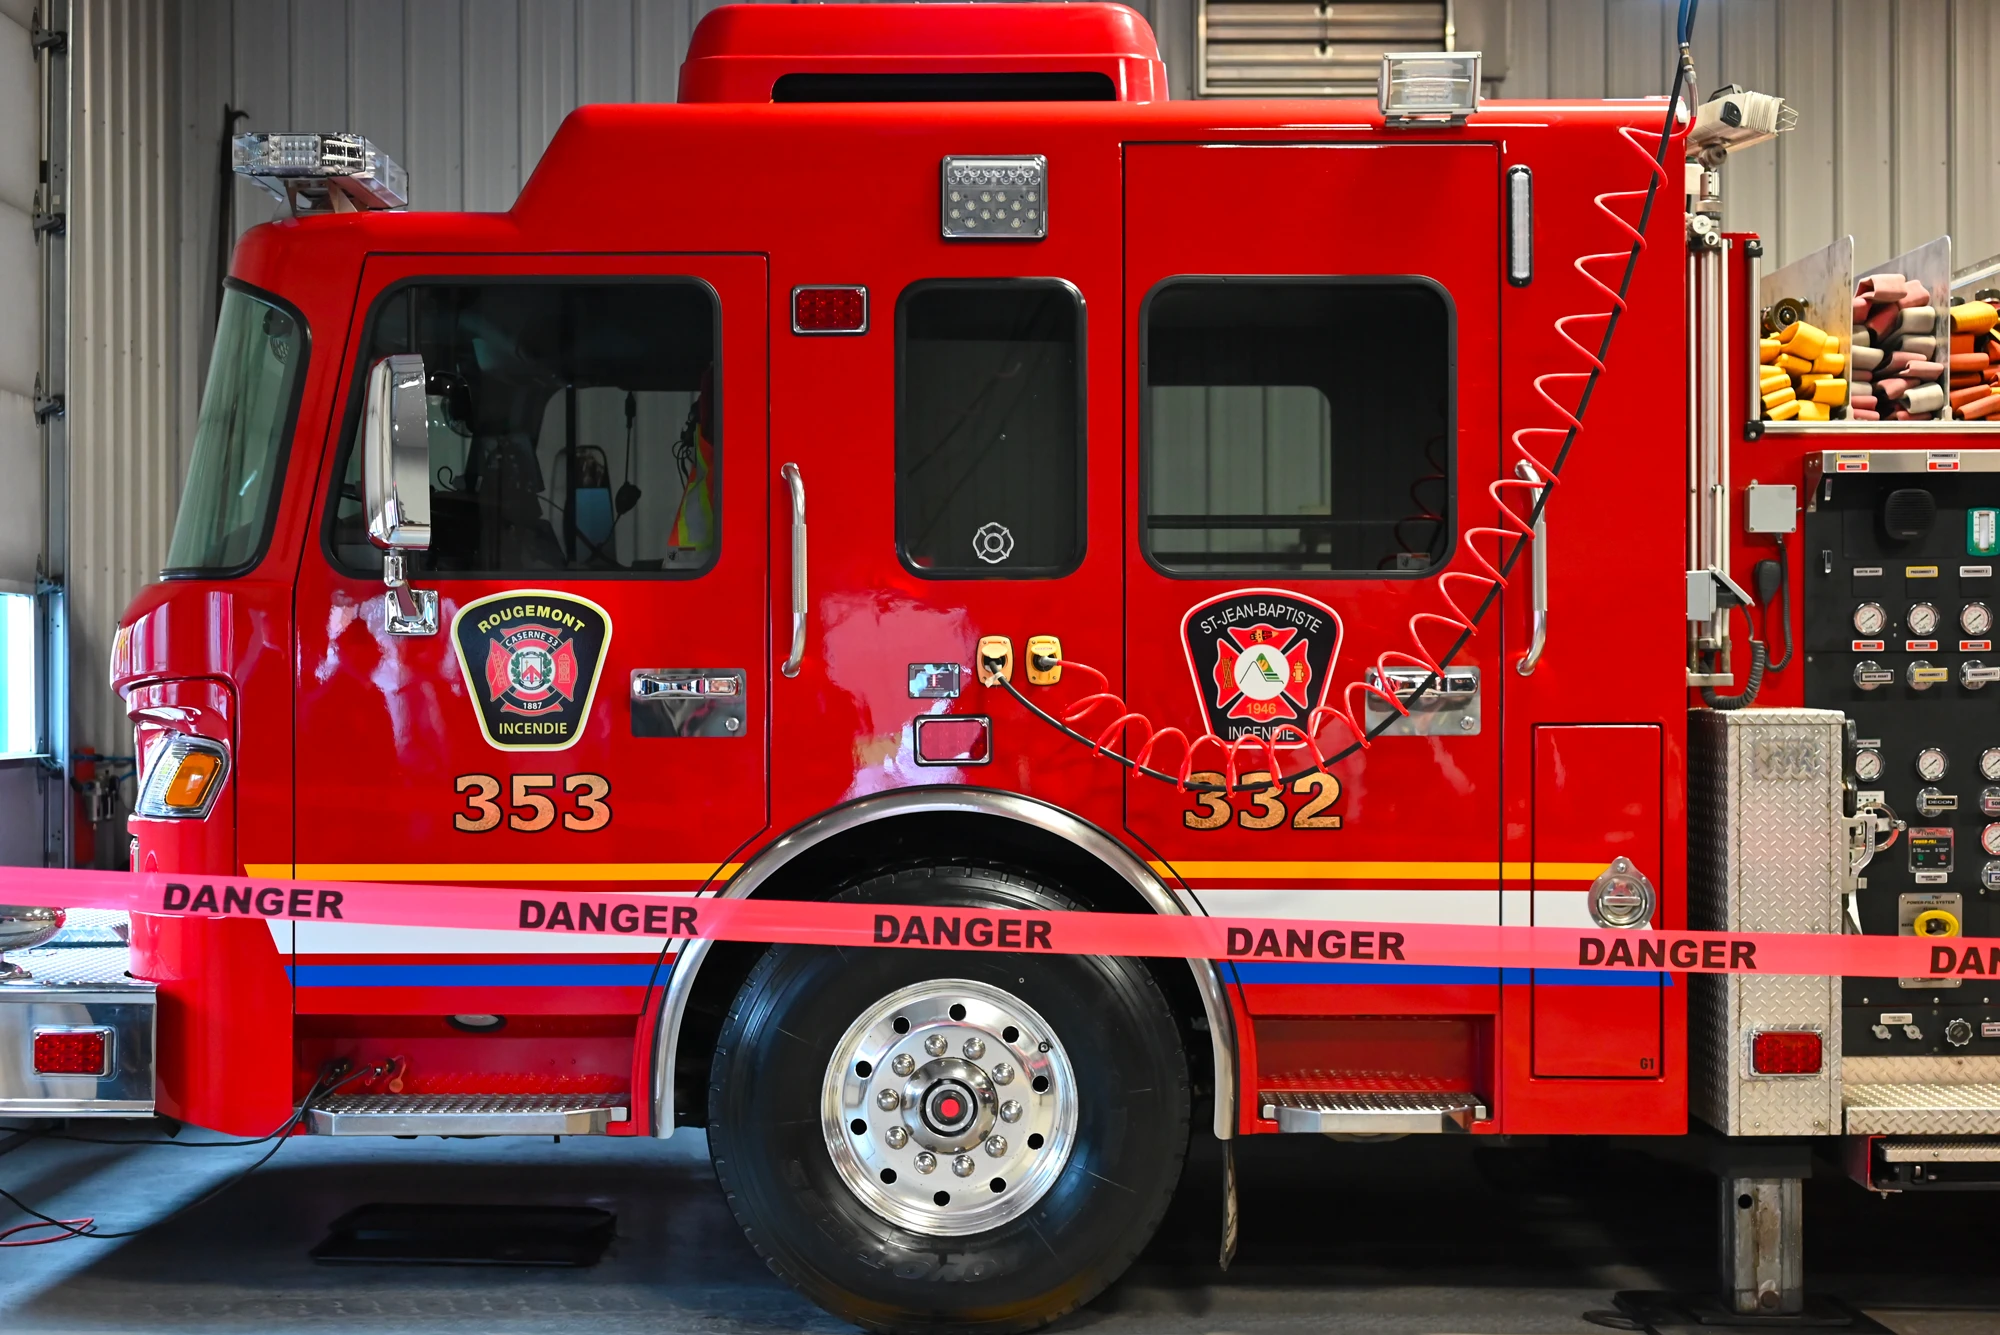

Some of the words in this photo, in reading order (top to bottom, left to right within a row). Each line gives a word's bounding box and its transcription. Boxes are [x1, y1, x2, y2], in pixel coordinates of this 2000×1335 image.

[478, 604, 586, 634] ROUGEMONT
[1200, 602, 1322, 634] ST-JEAN-BAPTISTE
[505, 630, 546, 646] CASERNE
[547, 636, 559, 647] 53
[522, 702, 542, 710] 1887
[1246, 704, 1276, 715] 1946
[499, 722, 568, 735] INCENDIE
[453, 772, 612, 834] 353
[1183, 770, 1344, 830] 332
[162, 883, 344, 920] DANGER
[518, 900, 699, 936] DANGER
[873, 914, 1052, 950] DANGER
[1226, 927, 1406, 962] DANGER
[1578, 937, 1757, 970] DANGER
[1640, 1058, 1654, 1070] G1
